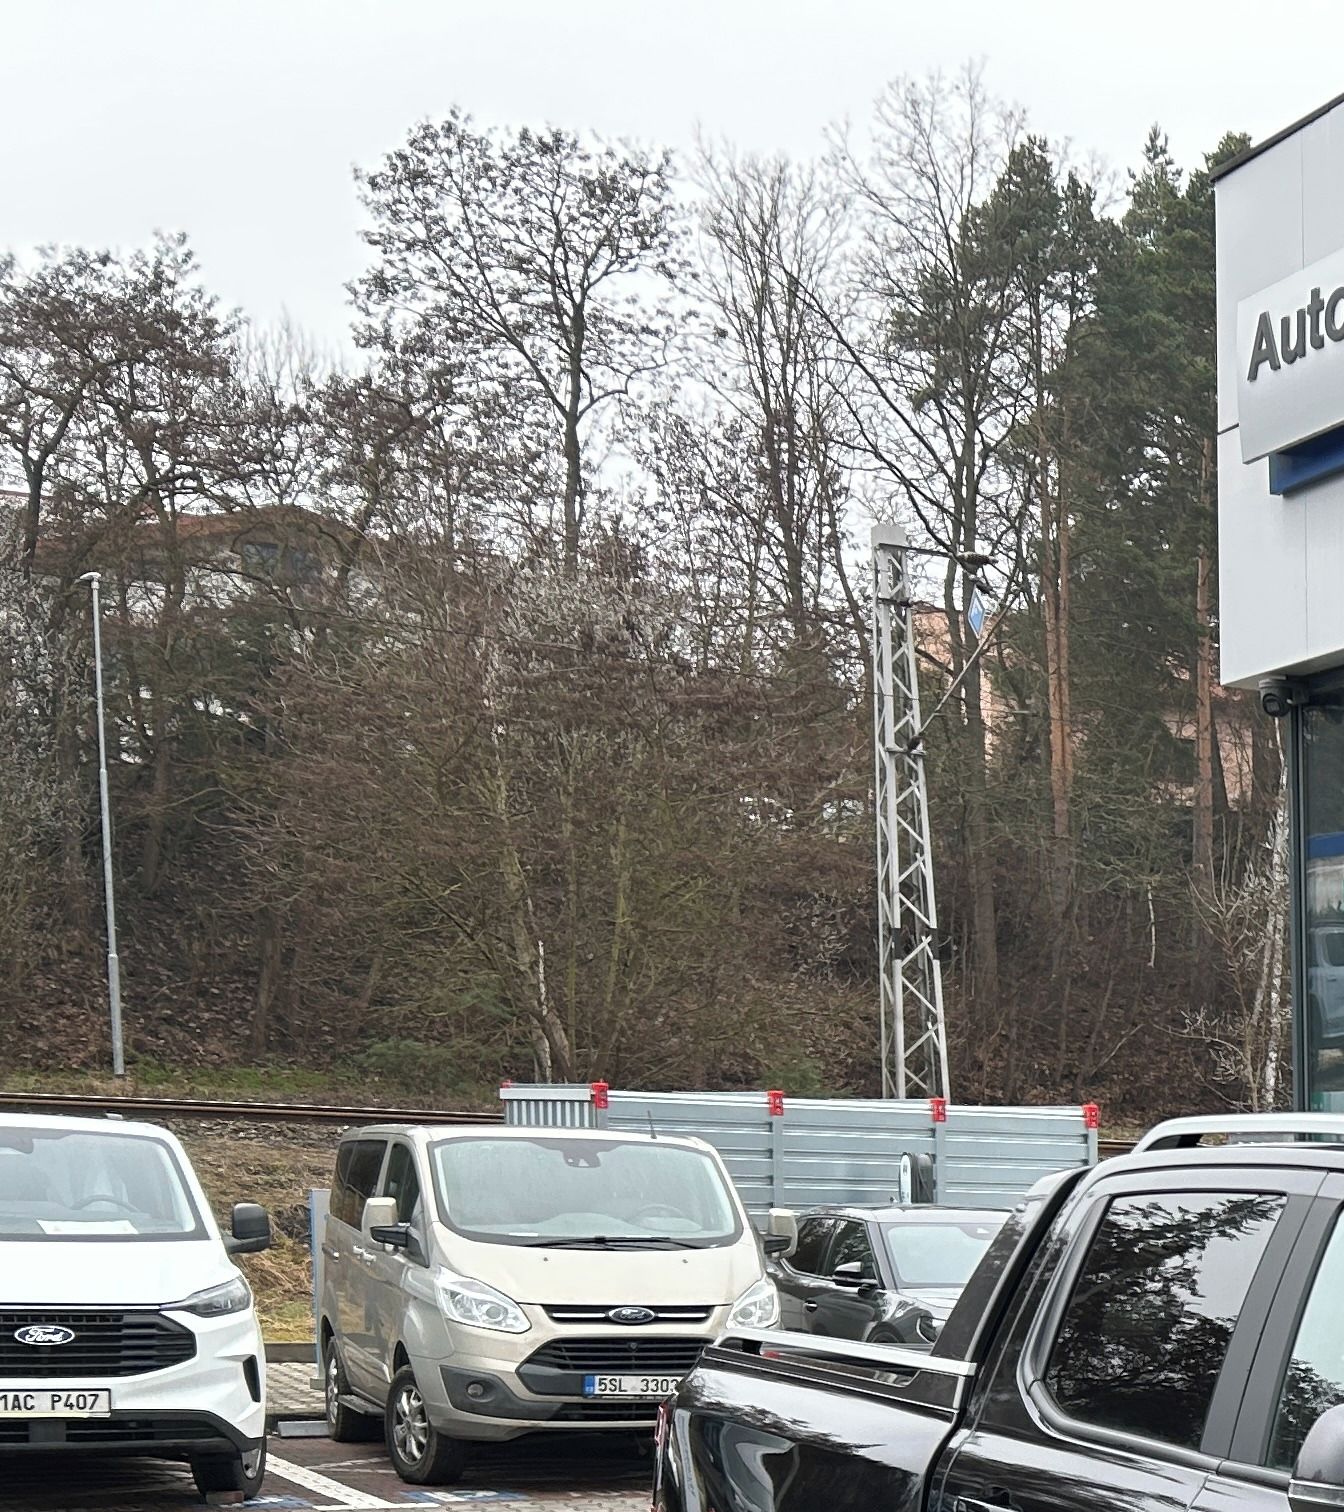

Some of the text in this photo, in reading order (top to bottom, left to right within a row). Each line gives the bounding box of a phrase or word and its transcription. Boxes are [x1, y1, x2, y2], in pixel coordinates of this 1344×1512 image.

[25, 1327, 64, 1342] Ford
[598, 1378, 628, 1392] 5SL
[0, 1393, 100, 1411] 1AC P407
